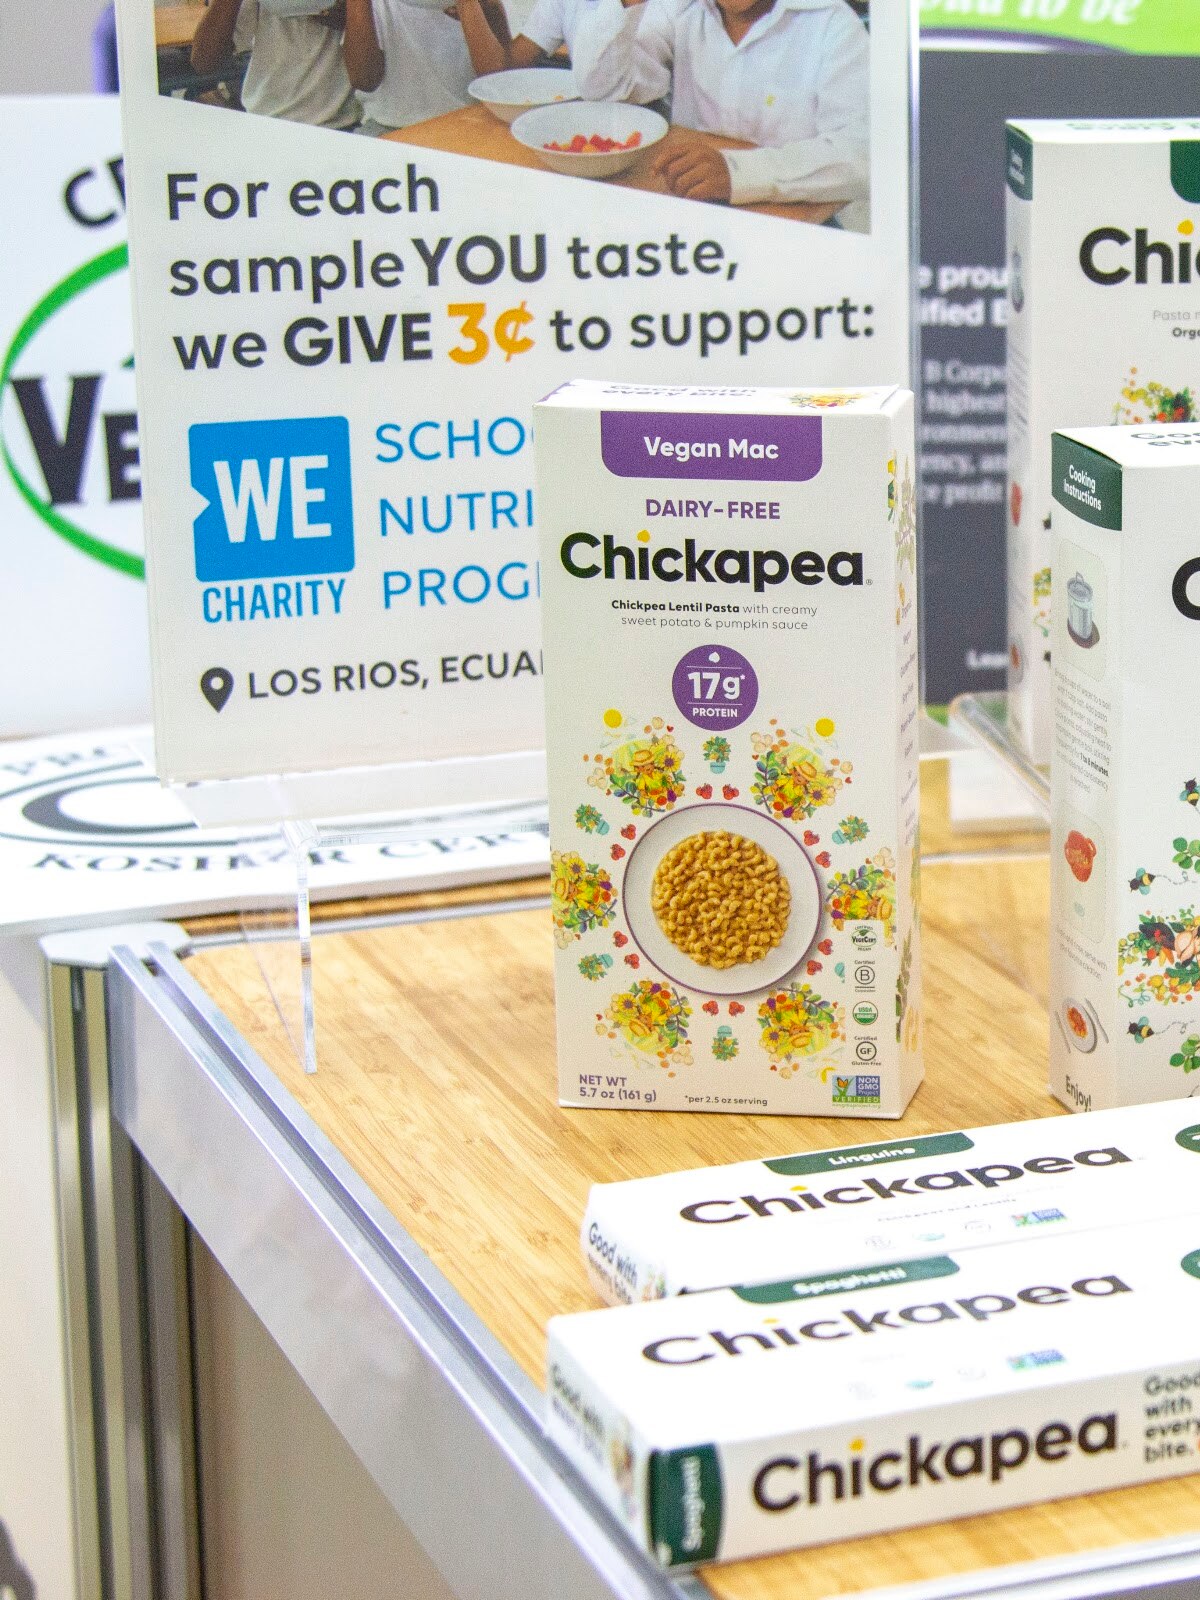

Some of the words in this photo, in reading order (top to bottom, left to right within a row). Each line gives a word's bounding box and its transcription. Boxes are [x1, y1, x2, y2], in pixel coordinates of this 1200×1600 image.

[167, 173, 269, 220] For
[290, 165, 440, 217] each
[169, 239, 405, 303] sample
[411, 234, 547, 286] YOU
[567, 234, 739, 282] taste,
[1152, 310, 1191, 321] Pasta
[173, 325, 268, 371] we
[283, 309, 432, 366] GIVE
[447, 301, 536, 366] 3¢
[550, 309, 611, 352] to
[629, 296, 875, 357] support:
[375, 416, 534, 463] SCHO
[643, 436, 722, 463] Vegan
[728, 438, 779, 460] Mac
[1064, 478, 1102, 511] Instructions
[1069, 464, 1096, 493] Cooking
[213, 454, 332, 544] WE
[560, 530, 864, 592] Chickapea
[203, 577, 346, 623] CHARITY
[383, 561, 541, 609] PROG
[611, 600, 666, 612] Chickpea
[669, 602, 703, 612] Lentil
[705, 603, 740, 613] Pasta
[743, 604, 769, 614] with
[772, 606, 818, 616] creamy
[621, 617, 657, 625] sweet
[660, 618, 700, 628] potato
[704, 618, 712, 628] &
[716, 619, 769, 630] pumpkin
[247, 666, 322, 700] LOS
[333, 658, 430, 691] RIOS,
[440, 650, 544, 684] ECUA
[692, 706, 738, 718] PROTEIN
[860, 969, 870, 981] B
[860, 1047, 872, 1055] GF
[579, 1074, 602, 1085] NET
[606, 1076, 627, 1087] WT
[579, 1087, 597, 1098] 5.7
[601, 1090, 615, 1099] oz
[618, 1088, 641, 1101] (161
[645, 1089, 657, 1103] g)
[1065, 1075, 1092, 1113] Enjoy!
[706, 1096, 719, 1104] 2.5
[734, 1097, 768, 1107] serving
[828, 1148, 916, 1165] Linguine
[680, 1145, 1132, 1225] Chickapea
[589, 1222, 617, 1264] Good
[643, 1273, 1134, 1365] Chickapea
[1145, 1396, 1192, 1417] with
[754, 1409, 1118, 1512] Chickapea
[1145, 1443, 1194, 1463] bite.
